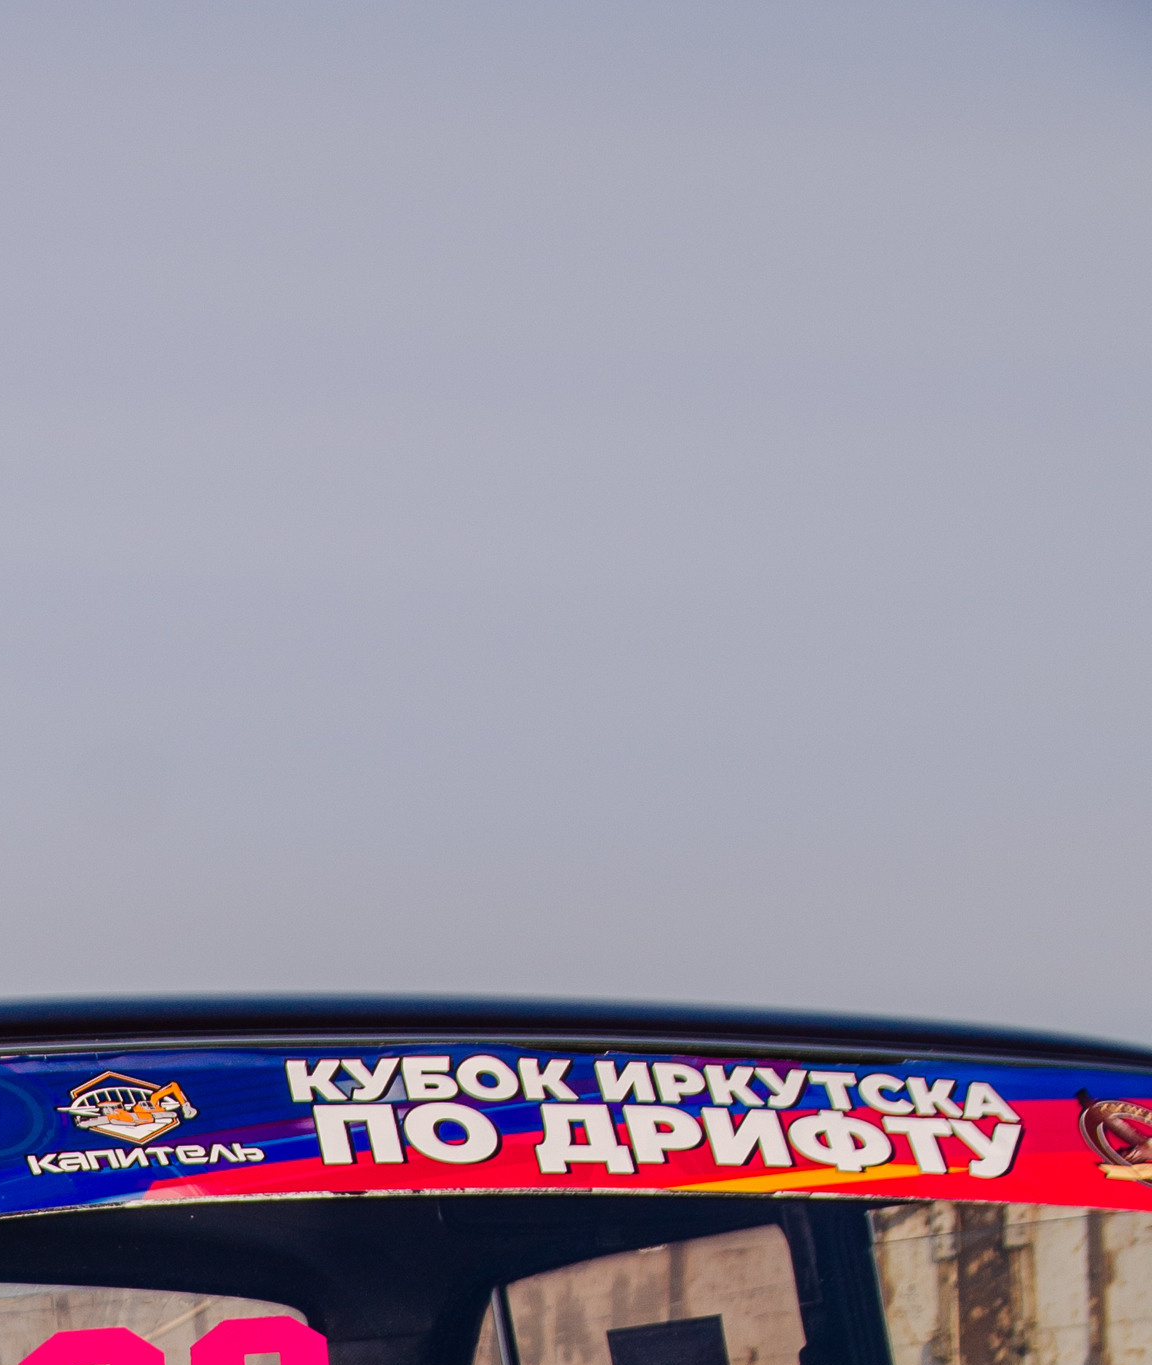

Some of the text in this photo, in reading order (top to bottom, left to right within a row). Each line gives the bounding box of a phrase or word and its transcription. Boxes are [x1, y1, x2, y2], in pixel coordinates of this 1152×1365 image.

[288, 1056, 1022, 1123] КУБОК ИРКУТСКА
[313, 1102, 1022, 1178] ПО ДРИФТУ
